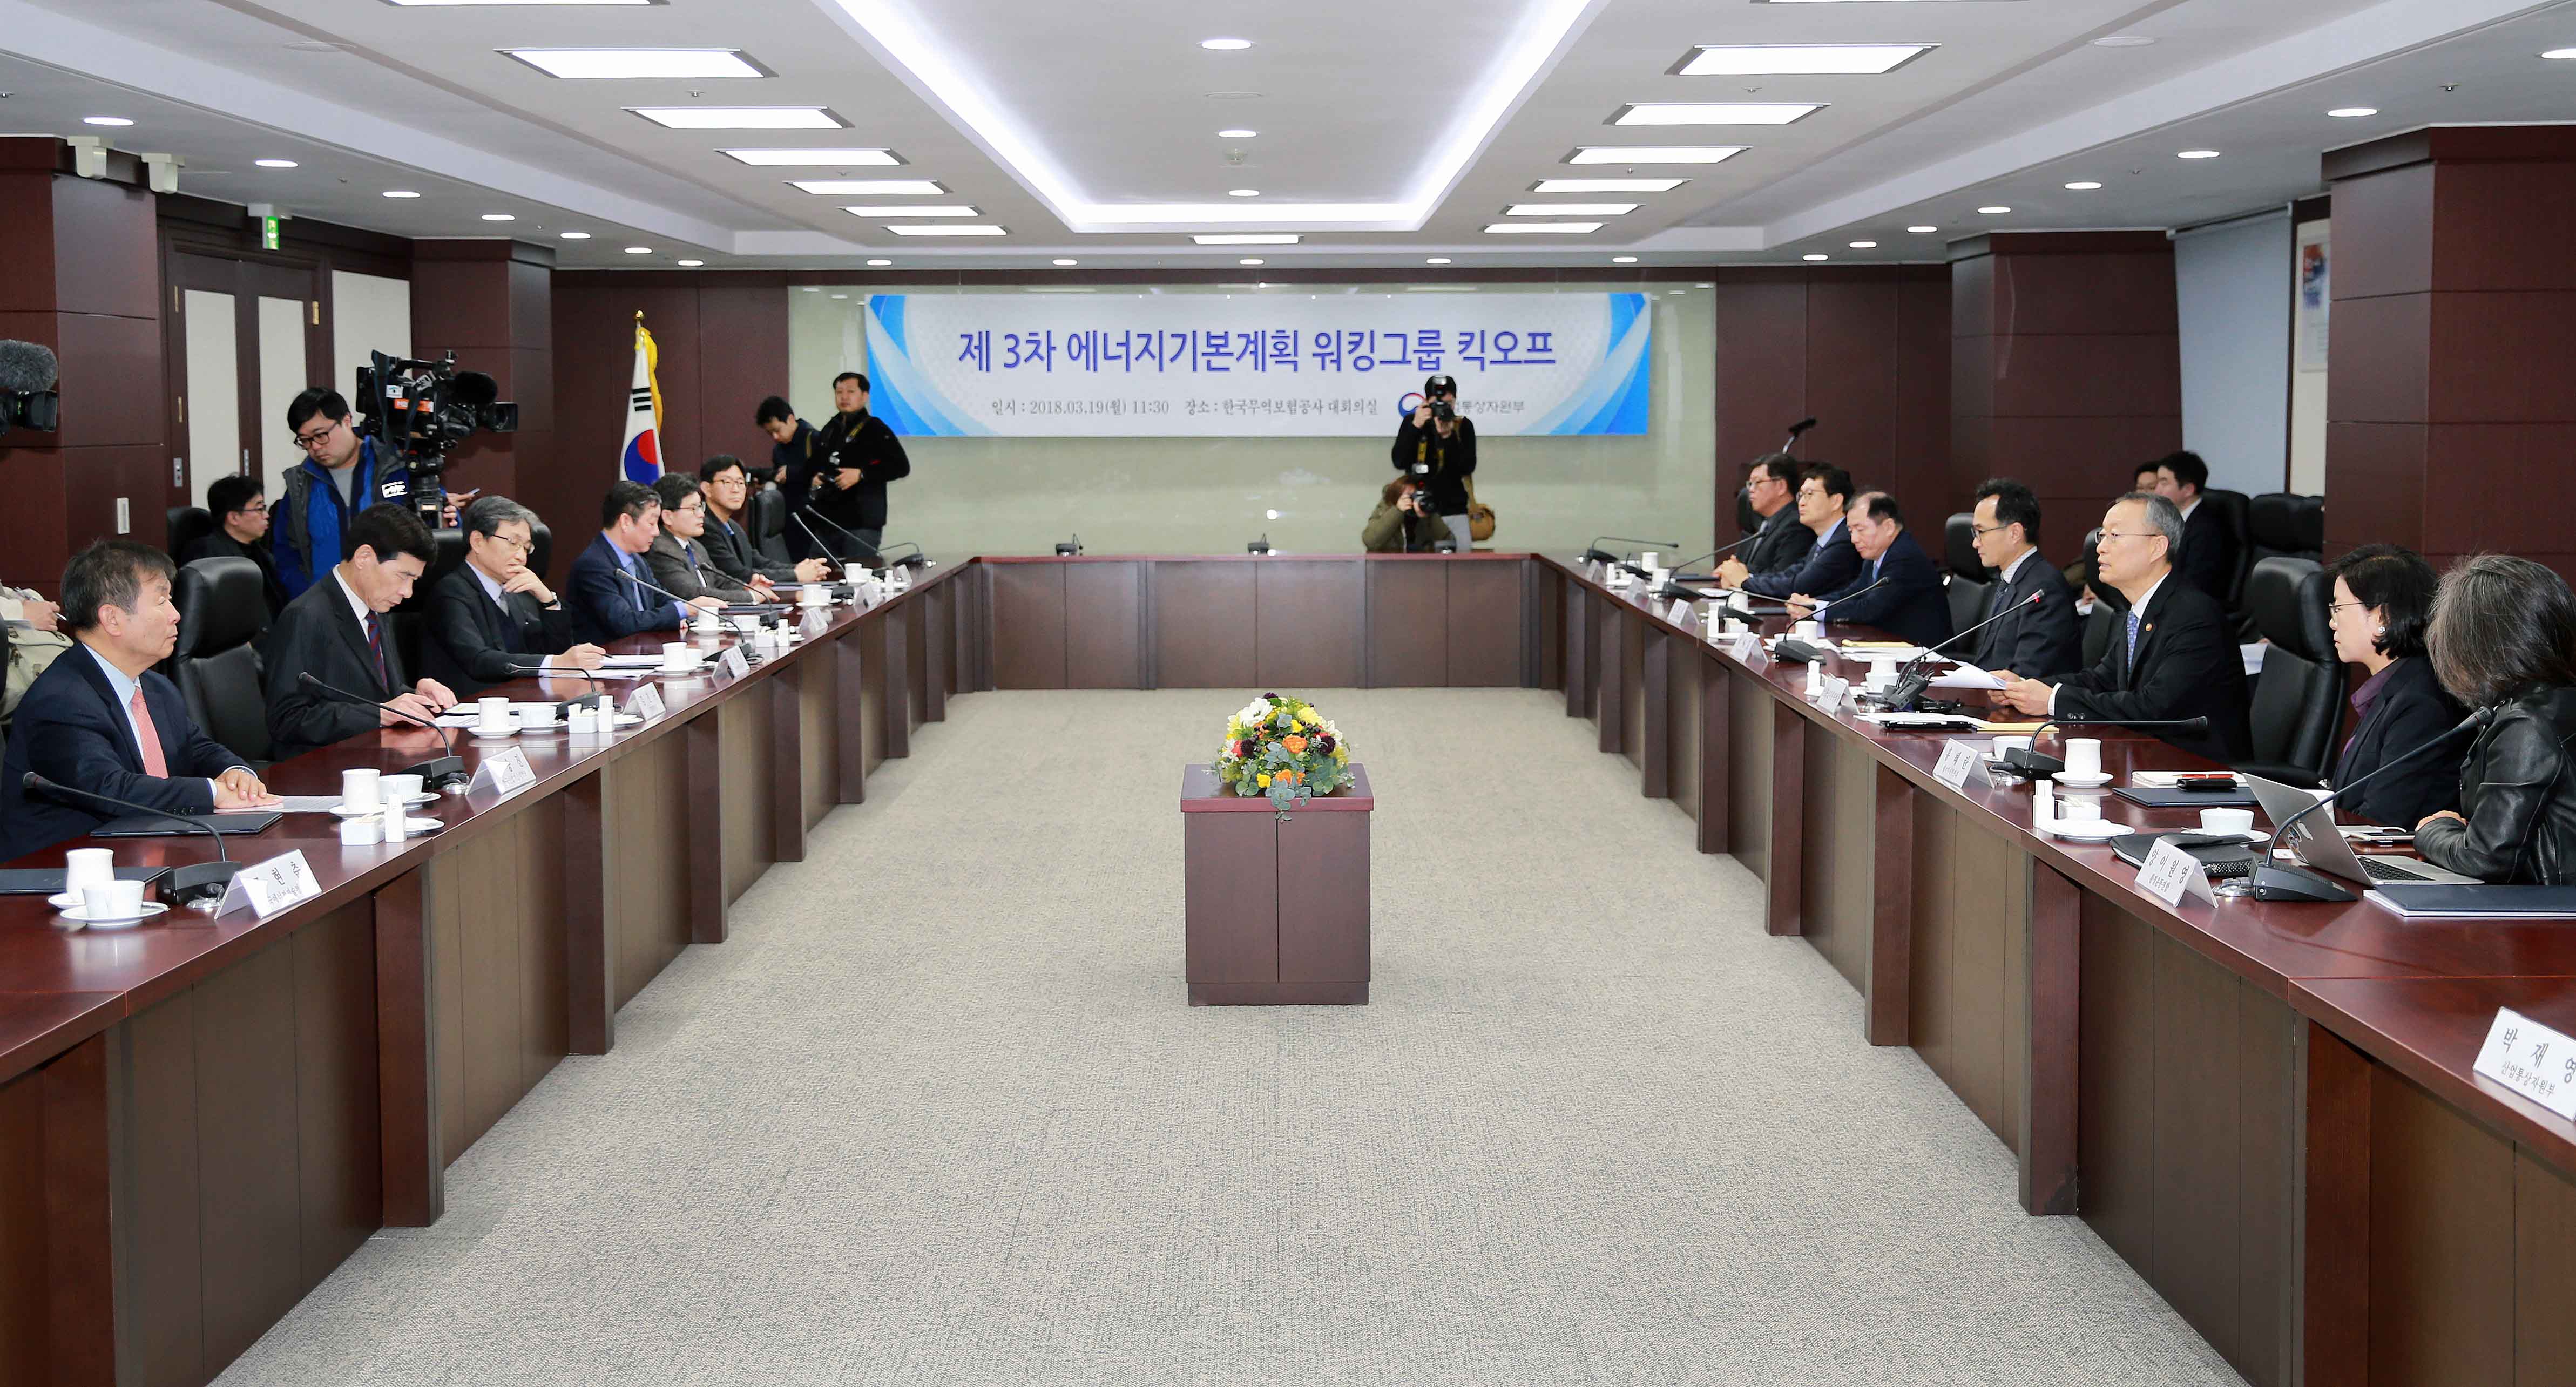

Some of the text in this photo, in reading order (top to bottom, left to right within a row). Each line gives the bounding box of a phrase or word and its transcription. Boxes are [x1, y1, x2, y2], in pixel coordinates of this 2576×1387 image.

[958, 330, 1556, 373] 제 3차 에너지기본계획 워킹그룹 킥오프
[991, 398, 1016, 415] 일시
[1030, 398, 1126, 415] 2018.03.19(월)
[1133, 400, 1169, 415] 11:30
[1185, 398, 1210, 415] 장소
[1222, 398, 1324, 415] 한국무역보험공사
[1328, 398, 1377, 415] 대회의실
[1456, 400, 1525, 415] 통상자원부
[2501, 1061, 2555, 1098] 산업통상자원부
